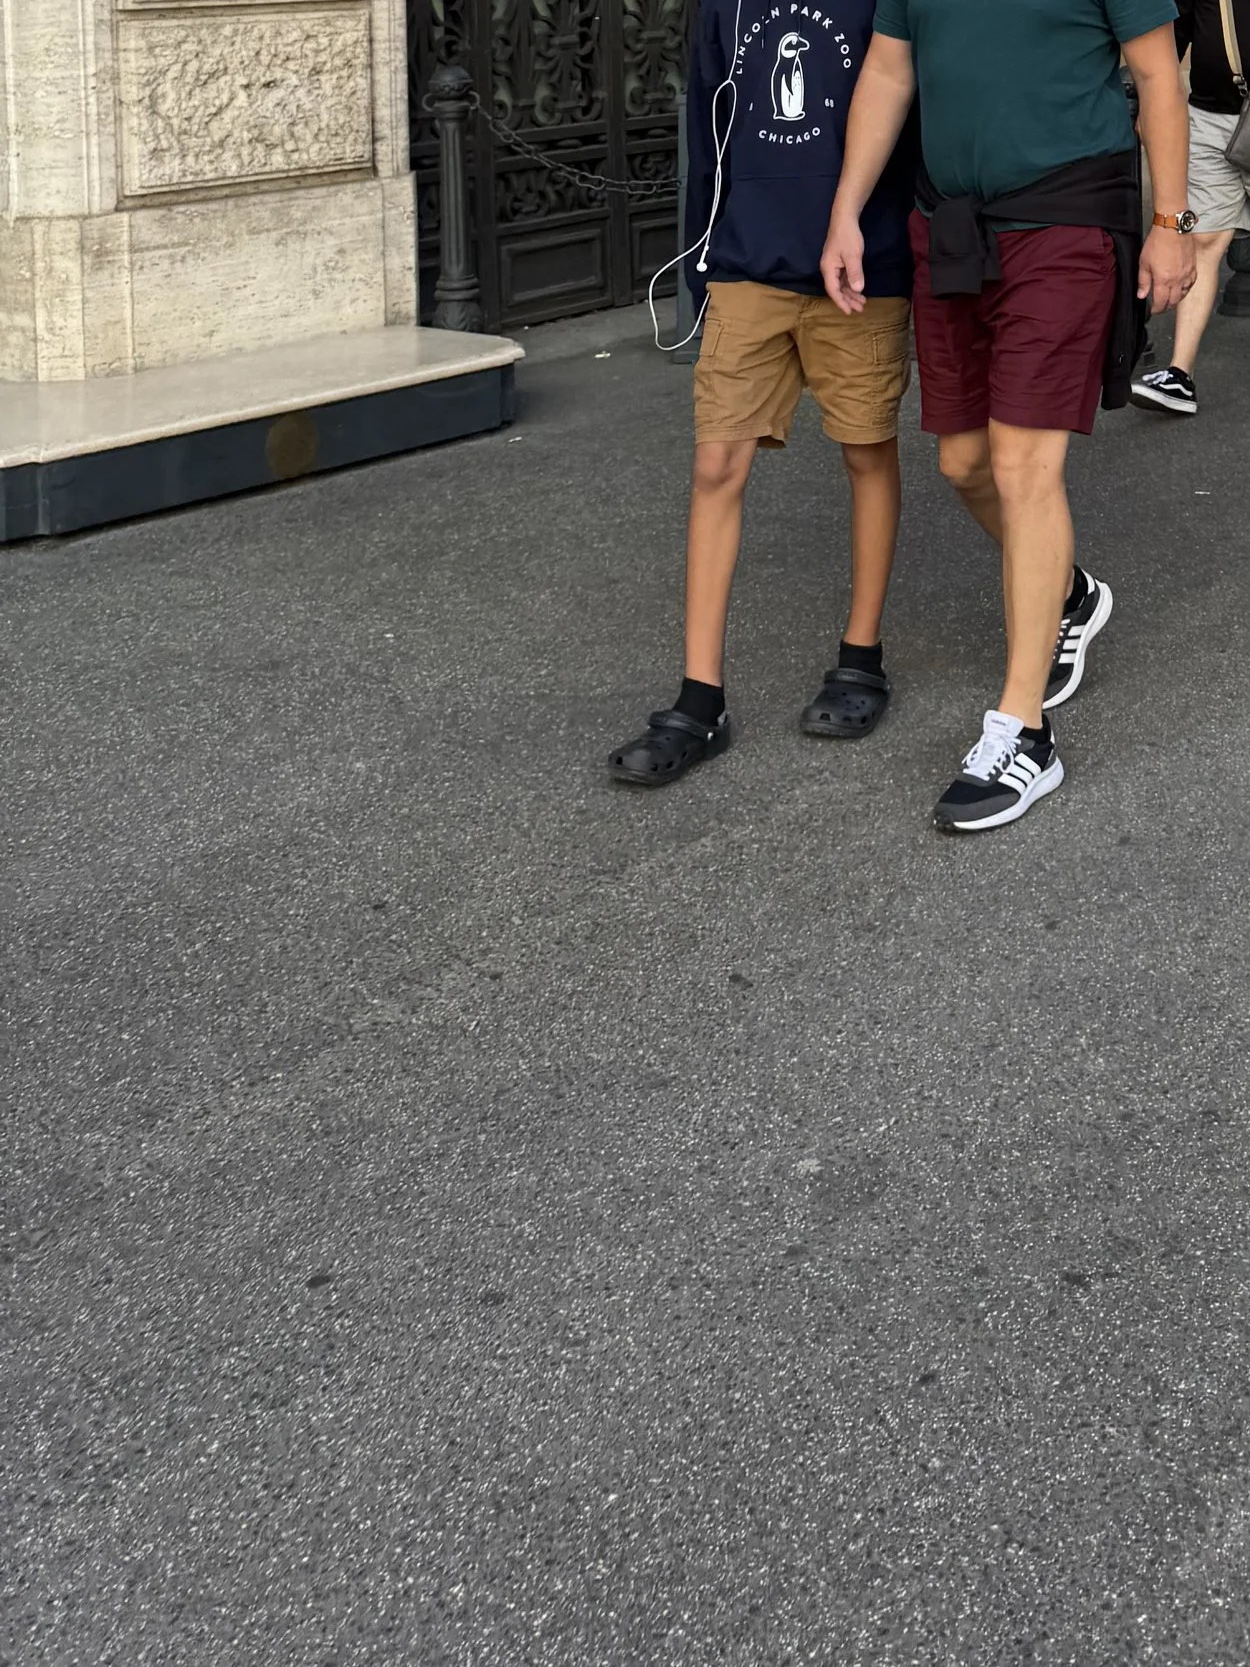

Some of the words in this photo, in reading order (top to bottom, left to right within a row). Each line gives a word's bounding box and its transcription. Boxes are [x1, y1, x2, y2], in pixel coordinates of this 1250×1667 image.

[790, 3, 833, 30] PARK
[834, 33, 852, 69] ZOO
[759, 127, 821, 145] CHICAGO
